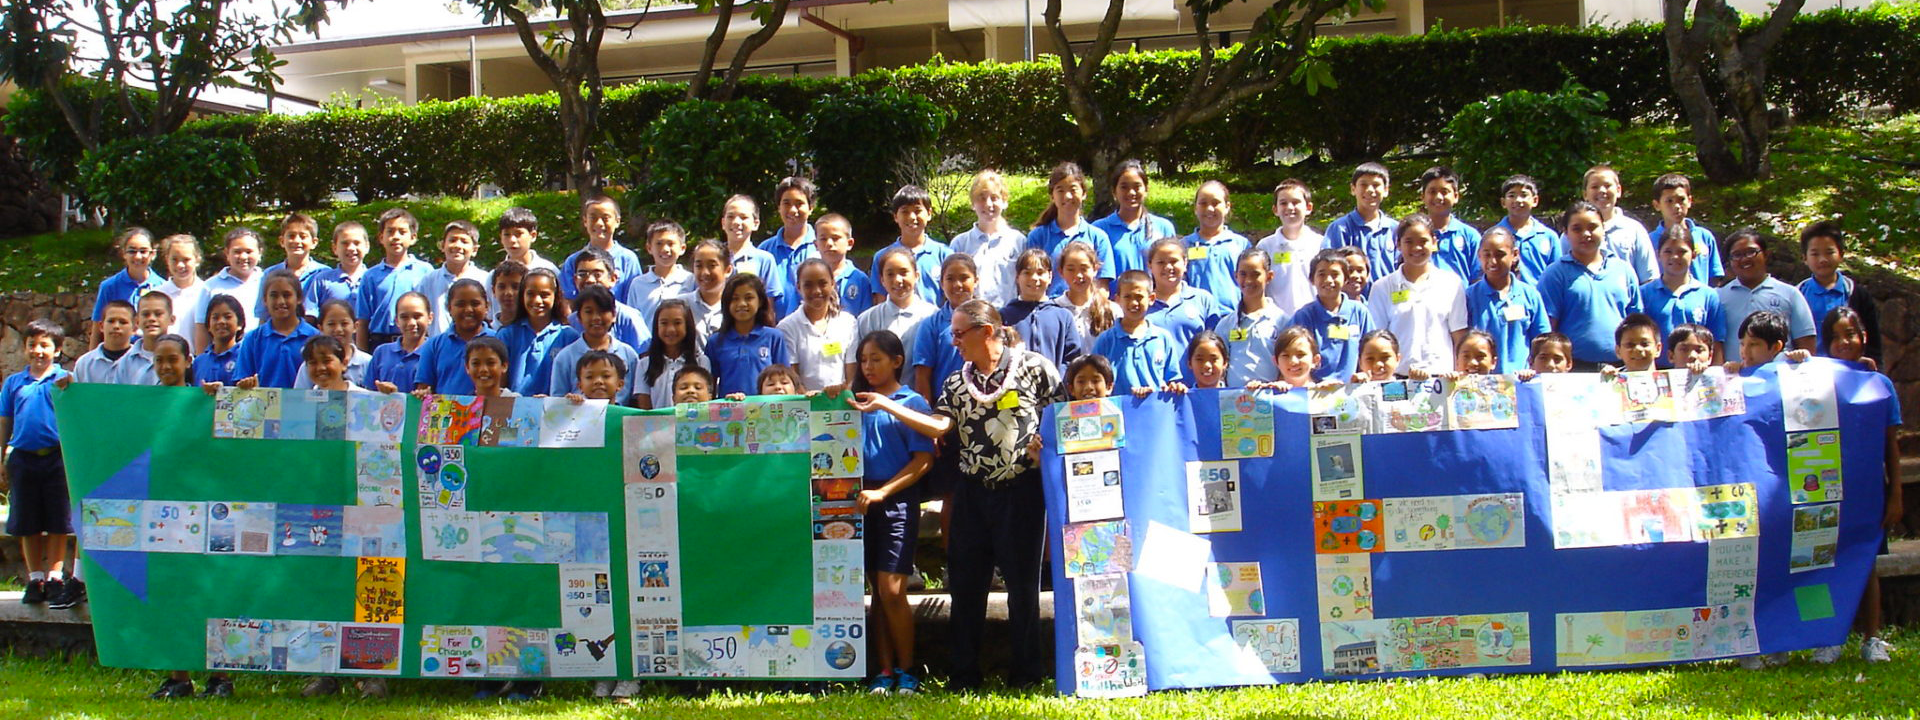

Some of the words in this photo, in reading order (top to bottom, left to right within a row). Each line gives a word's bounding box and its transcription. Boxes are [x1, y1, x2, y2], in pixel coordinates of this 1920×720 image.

[445, 449, 461, 460] 350
[1200, 468, 1231, 481] 350
[1735, 544, 1752, 553] CAN
[1715, 556, 1740, 566] MAKE
[568, 579, 585, 589] 390
[566, 591, 585, 600] 350
[434, 626, 472, 637] Friends
[528, 631, 547, 642] 350
[816, 623, 863, 639] 350
[447, 638, 462, 647] For
[437, 647, 473, 658] Change
[703, 636, 737, 661] 350
[447, 657, 462, 675] 5
